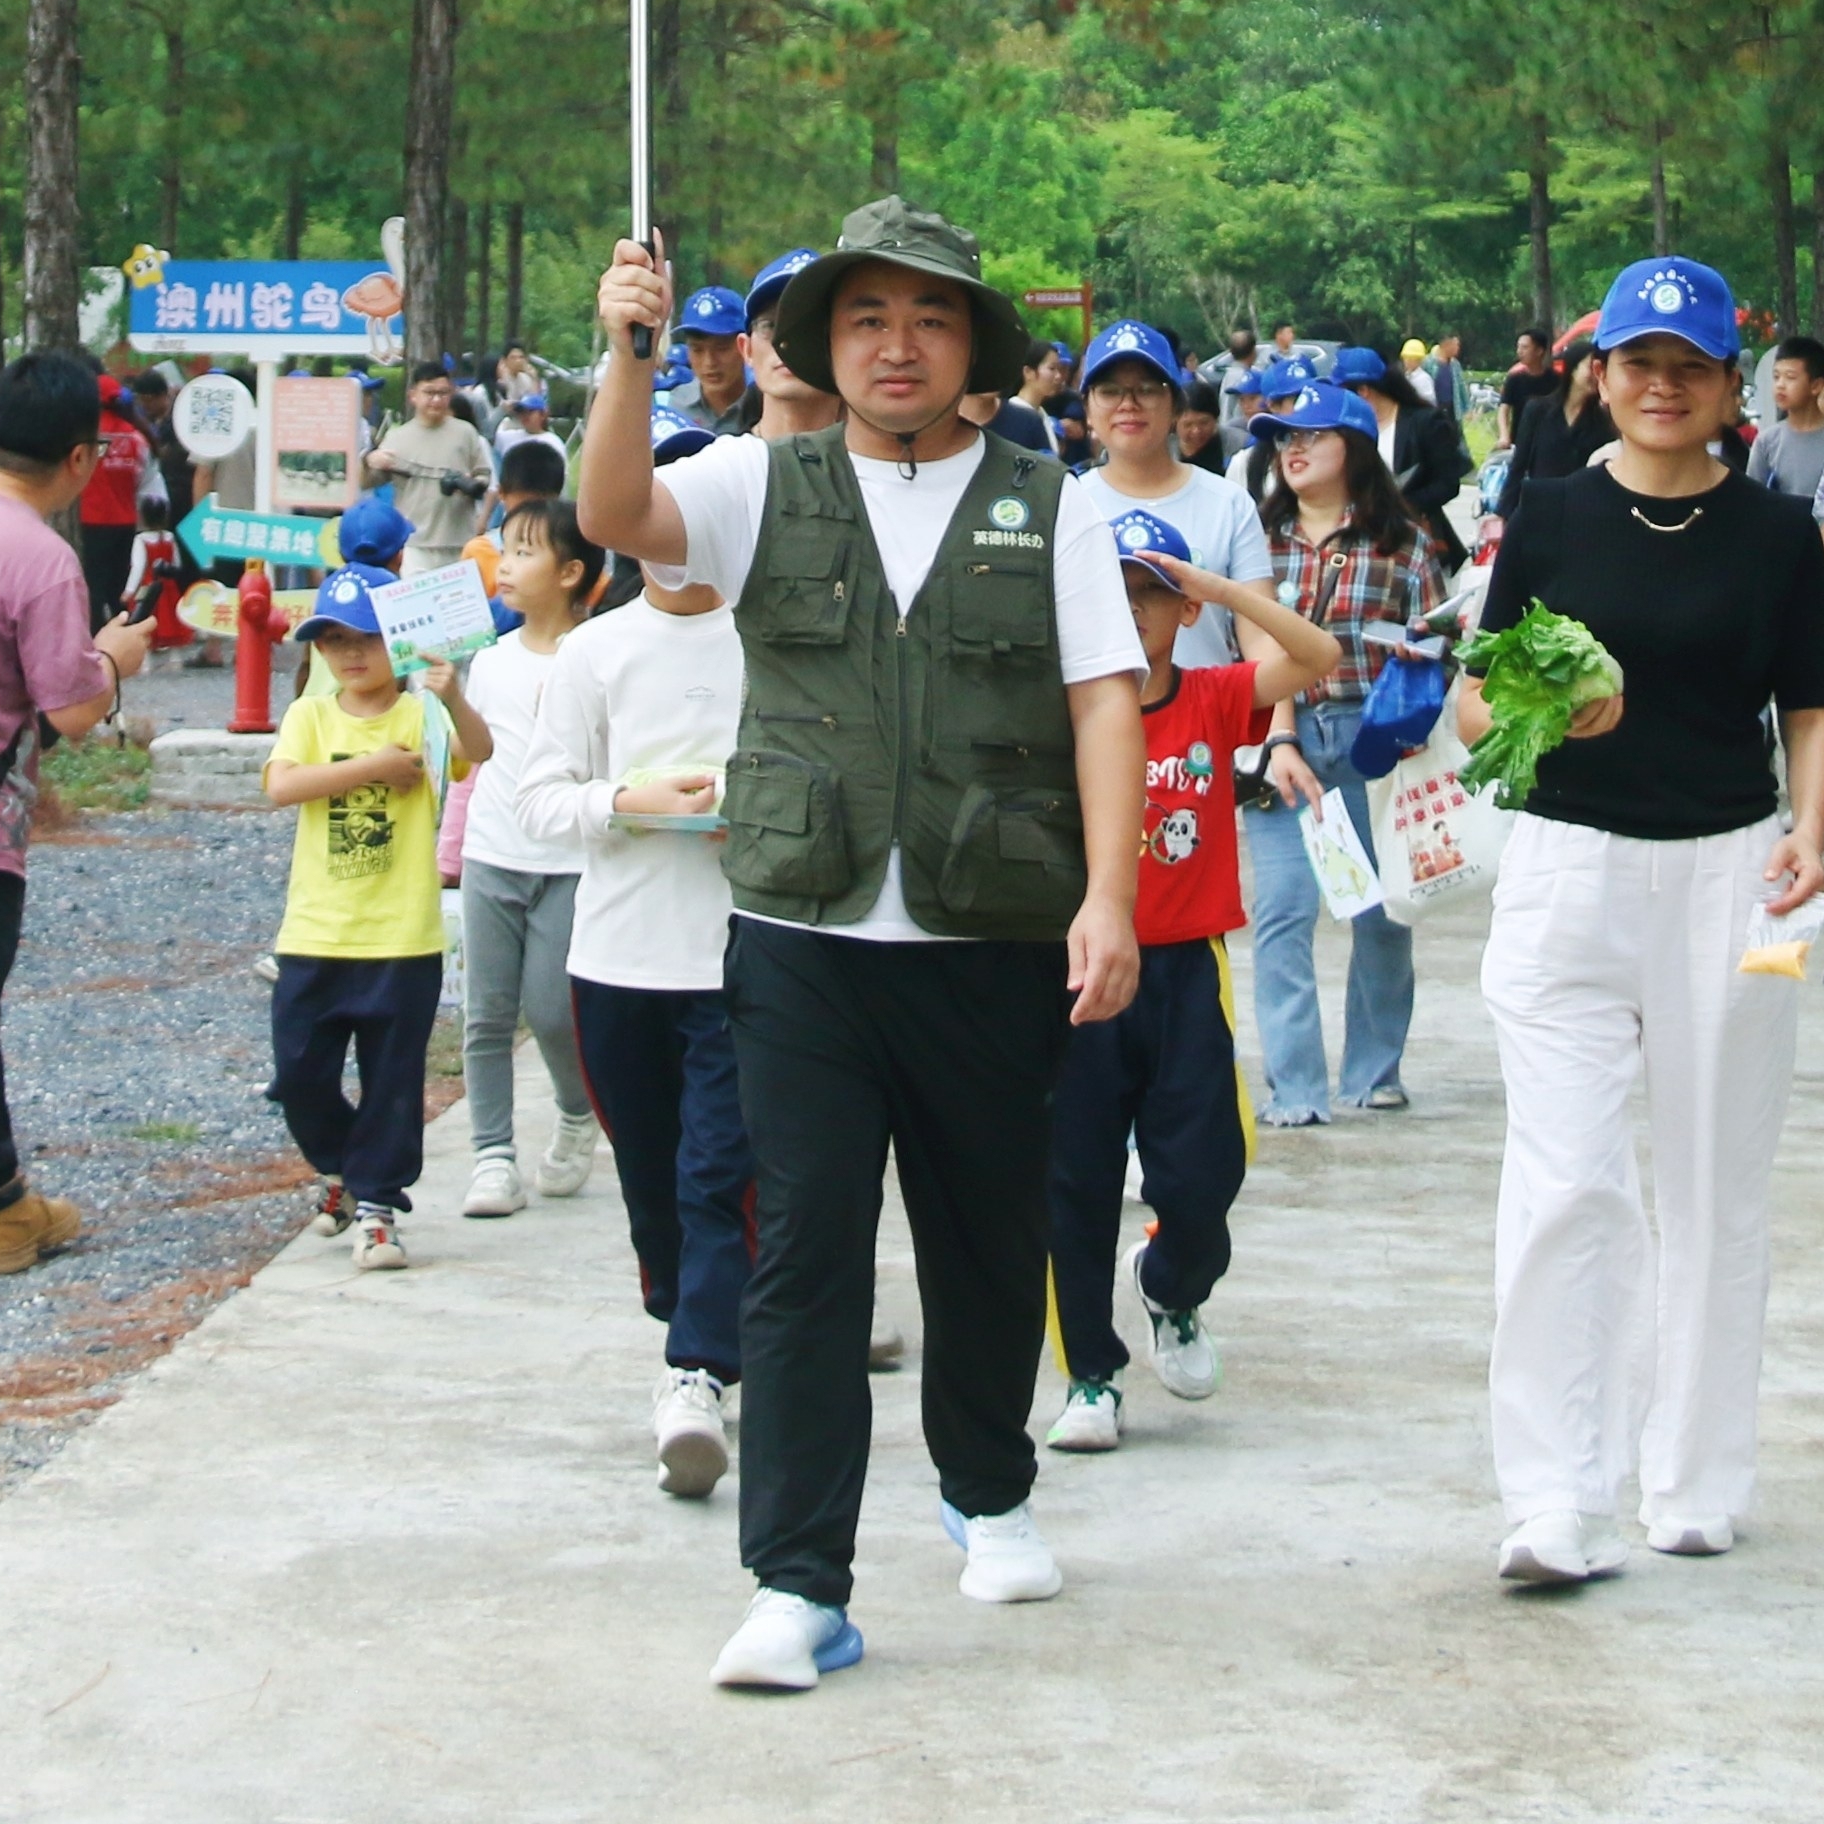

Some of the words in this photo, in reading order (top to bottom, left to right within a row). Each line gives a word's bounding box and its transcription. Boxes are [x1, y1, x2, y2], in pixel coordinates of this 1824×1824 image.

[972, 529, 1045, 549] 英德林长办
